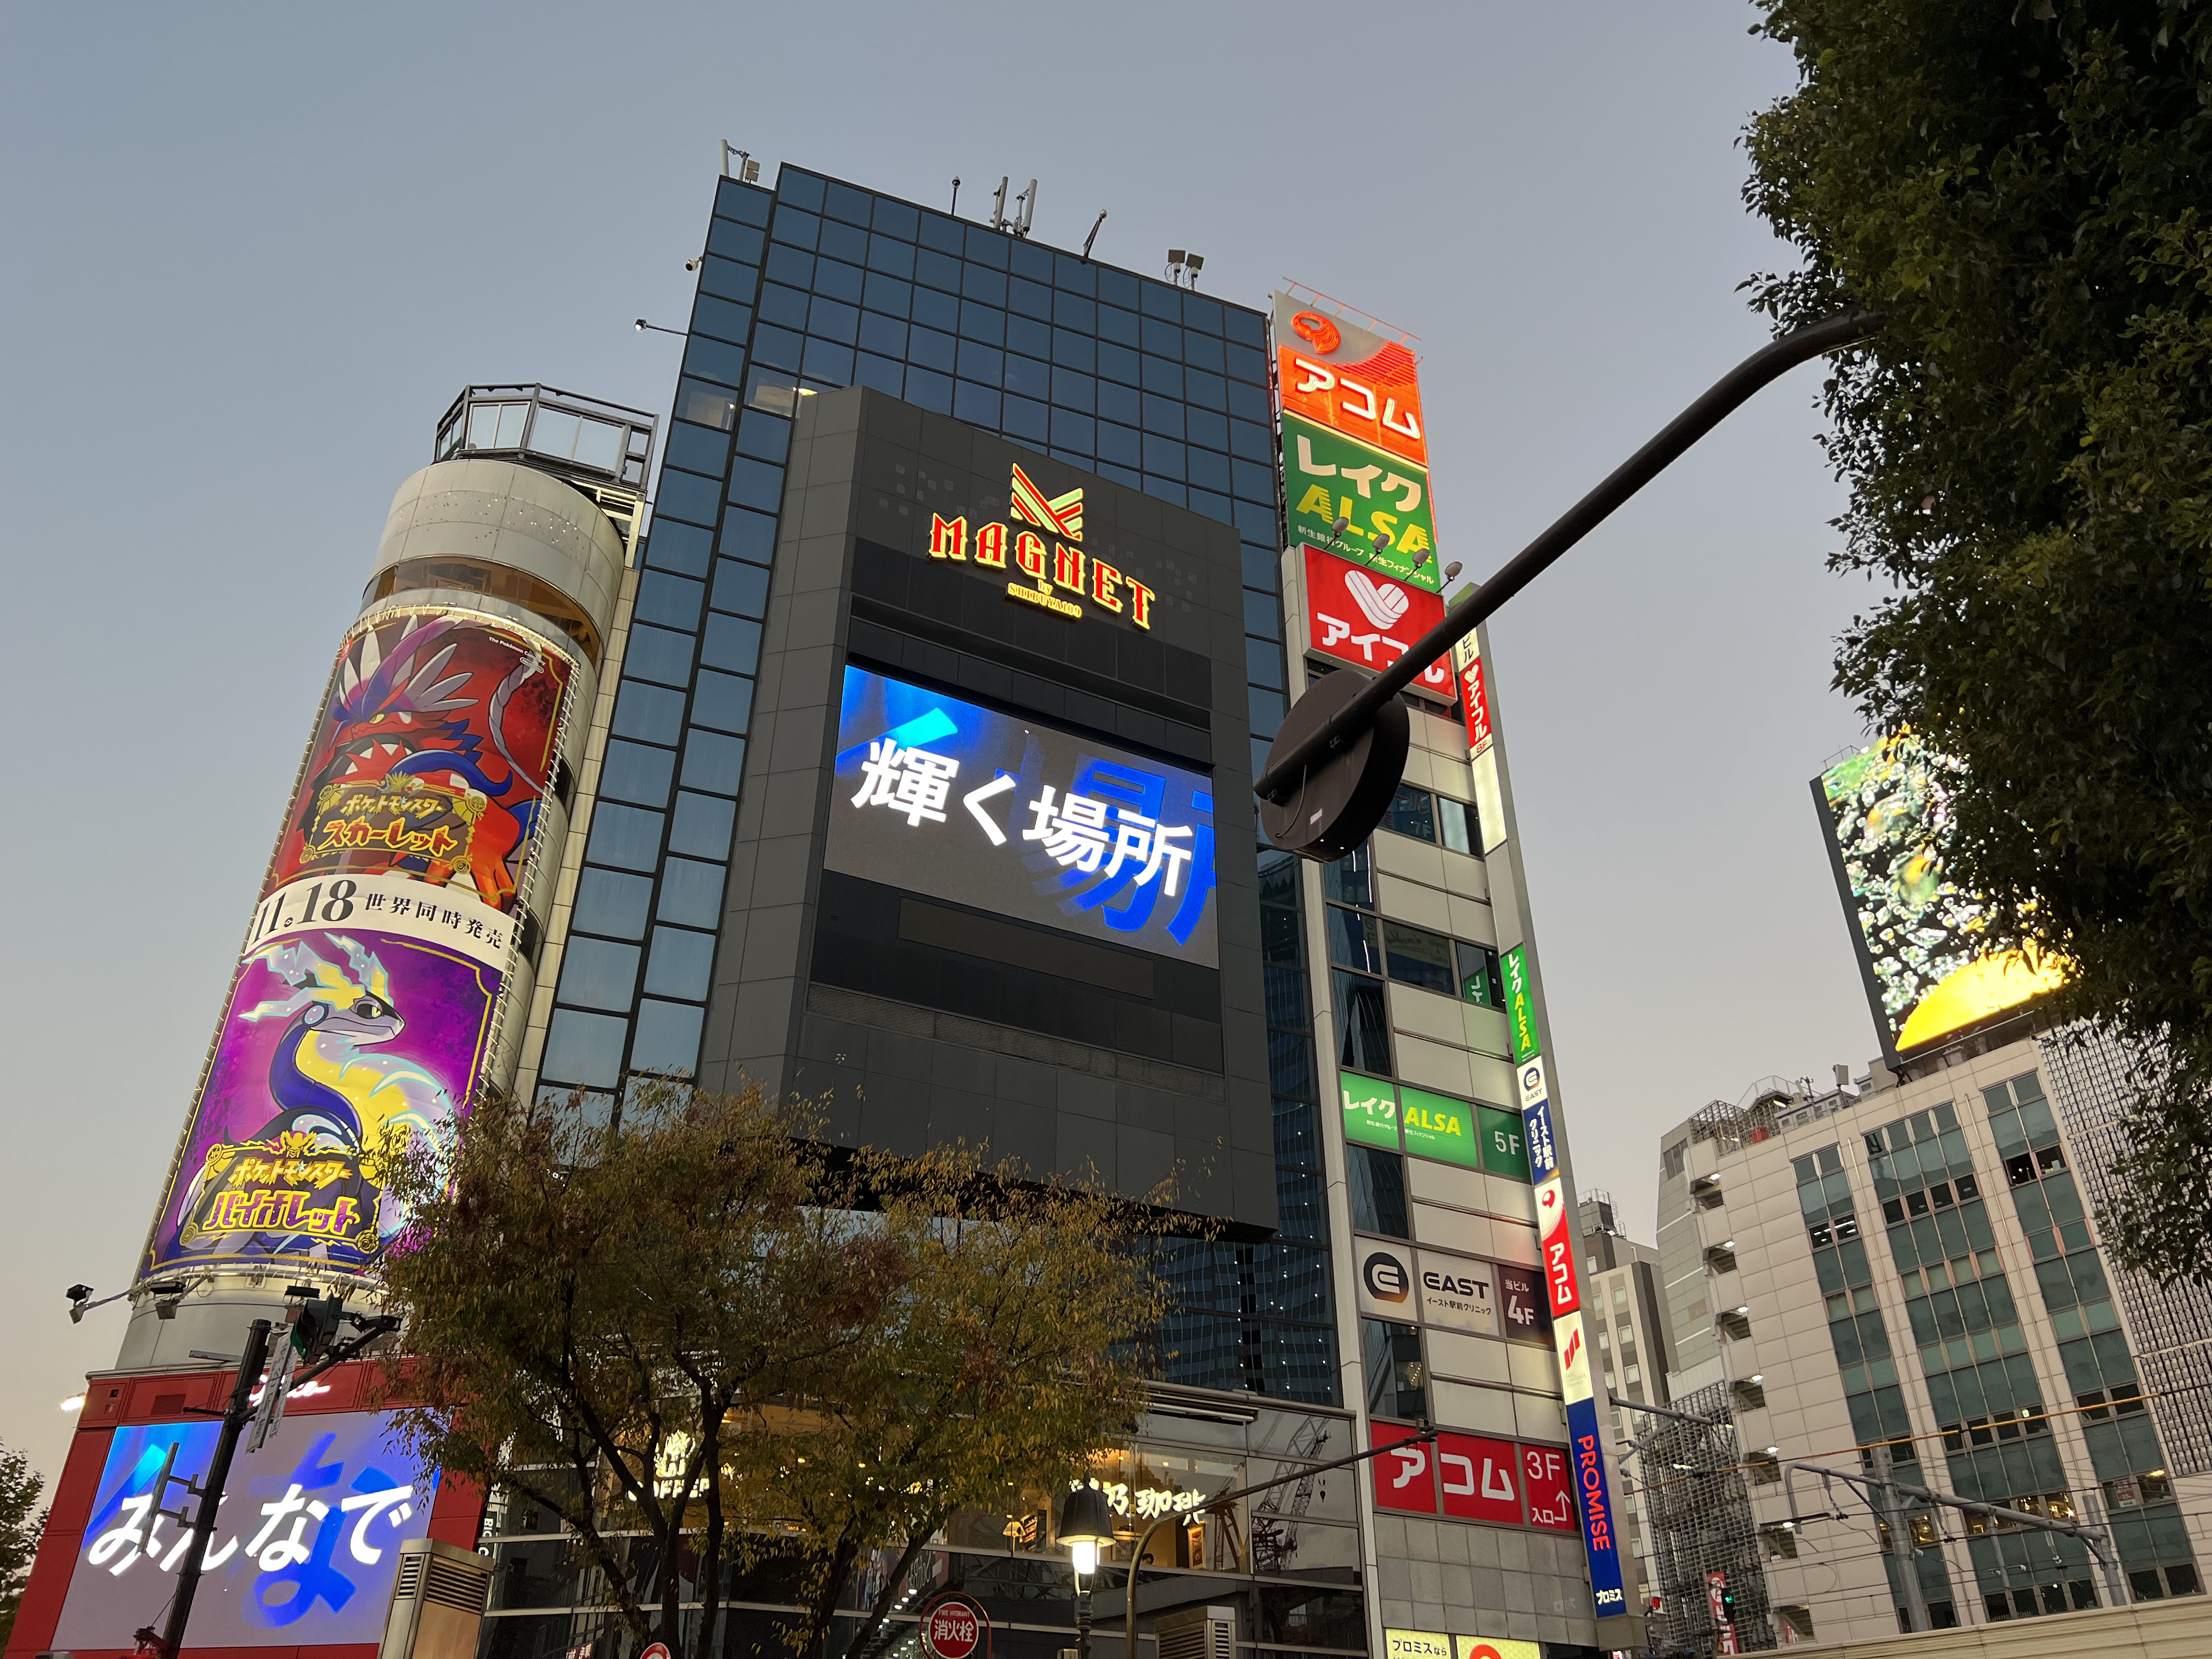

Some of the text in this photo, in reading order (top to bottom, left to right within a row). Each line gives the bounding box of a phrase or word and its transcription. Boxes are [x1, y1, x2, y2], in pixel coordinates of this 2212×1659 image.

[1294, 358, 1421, 439] アコム
[1297, 435, 1421, 512] レイク
[1296, 484, 1432, 563] ALSA
[928, 512, 1155, 630] MAGNET
[1297, 525, 1434, 584] 新生銀行グループ 新生フィナンシャル
[1008, 583, 1082, 618] SHIBUYA109
[1037, 579, 1053, 595] by
[500, 640, 523, 653] Pokémon
[1468, 680, 1487, 742] アイフル
[1476, 740, 1488, 753] 8F
[343, 794, 445, 818] ポケットモンスター
[850, 738, 1193, 896] 輝く場所
[318, 817, 458, 856] スカーレット
[365, 893, 503, 949] 世界同時発売
[1509, 953, 1522, 994] レイク
[1515, 992, 1531, 1052] ALSA
[1343, 1090, 1395, 1119] レイク
[1525, 1088, 1543, 1102] EAST
[1404, 1106, 1462, 1136] ALSA
[1494, 1131, 1520, 1155] 5F
[1530, 1118, 1543, 1168] クリニック
[228, 1157, 353, 1189] ポケットモンスター
[203, 1190, 360, 1235] バイオレット
[1423, 1272, 1489, 1299] EAST
[1505, 1279, 1529, 1293] 当ビル
[1549, 1243, 1572, 1305] アコム
[1427, 1297, 1491, 1315] イースト駅前クリニック
[1508, 1295, 1534, 1325] 4F
[1390, 1447, 1515, 1501] アコム
[1526, 1451, 1560, 1481] 3F
[1578, 1435, 1610, 1551] PROMISE
[87, 1483, 413, 1576] みんなで
[1532, 1507, 1554, 1525] 入口
[934, 1619, 974, 1642] 消火栓
[1392, 1639, 1447, 1656] プロミスなら
